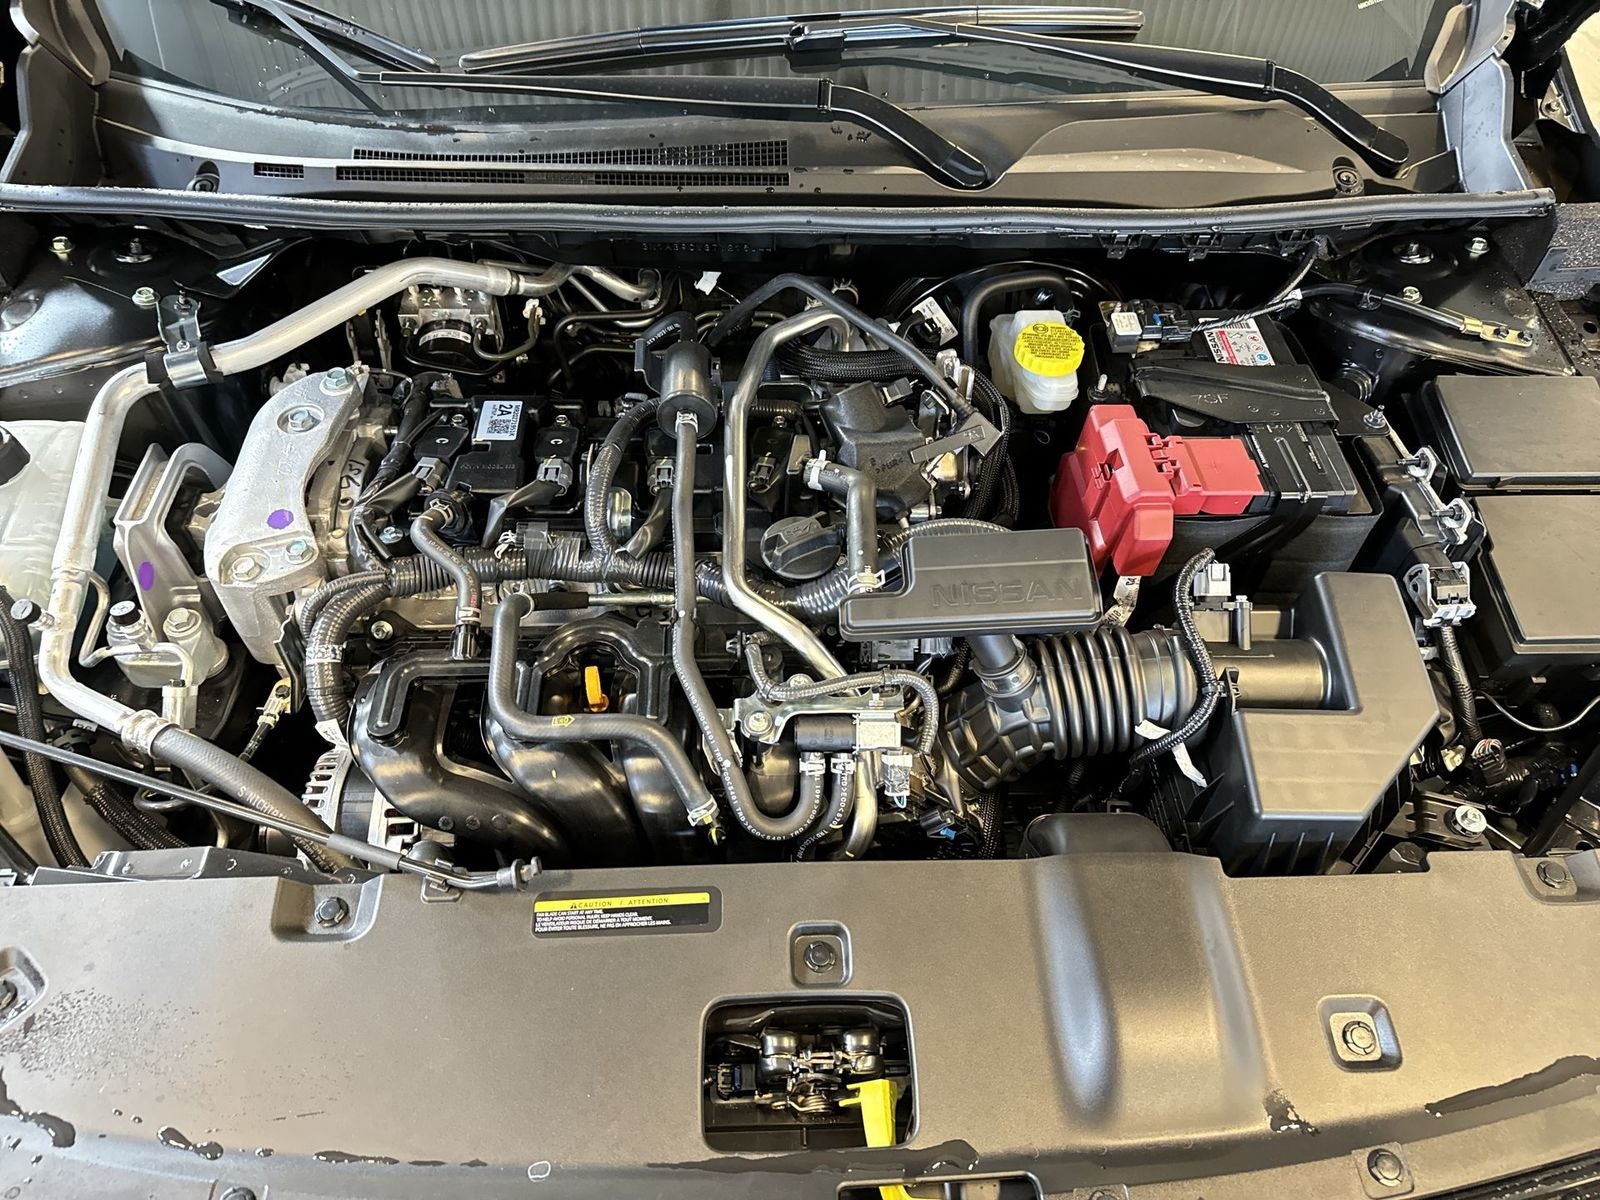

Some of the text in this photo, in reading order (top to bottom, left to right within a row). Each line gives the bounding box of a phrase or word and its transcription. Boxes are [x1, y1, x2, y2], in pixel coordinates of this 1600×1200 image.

[1205, 331, 1225, 363] NISSAN
[496, 404, 513, 417] 2A
[929, 577, 1085, 608] NISSAN
[578, 900, 612, 909] CAUTION
[628, 897, 669, 905] ATTENTION
